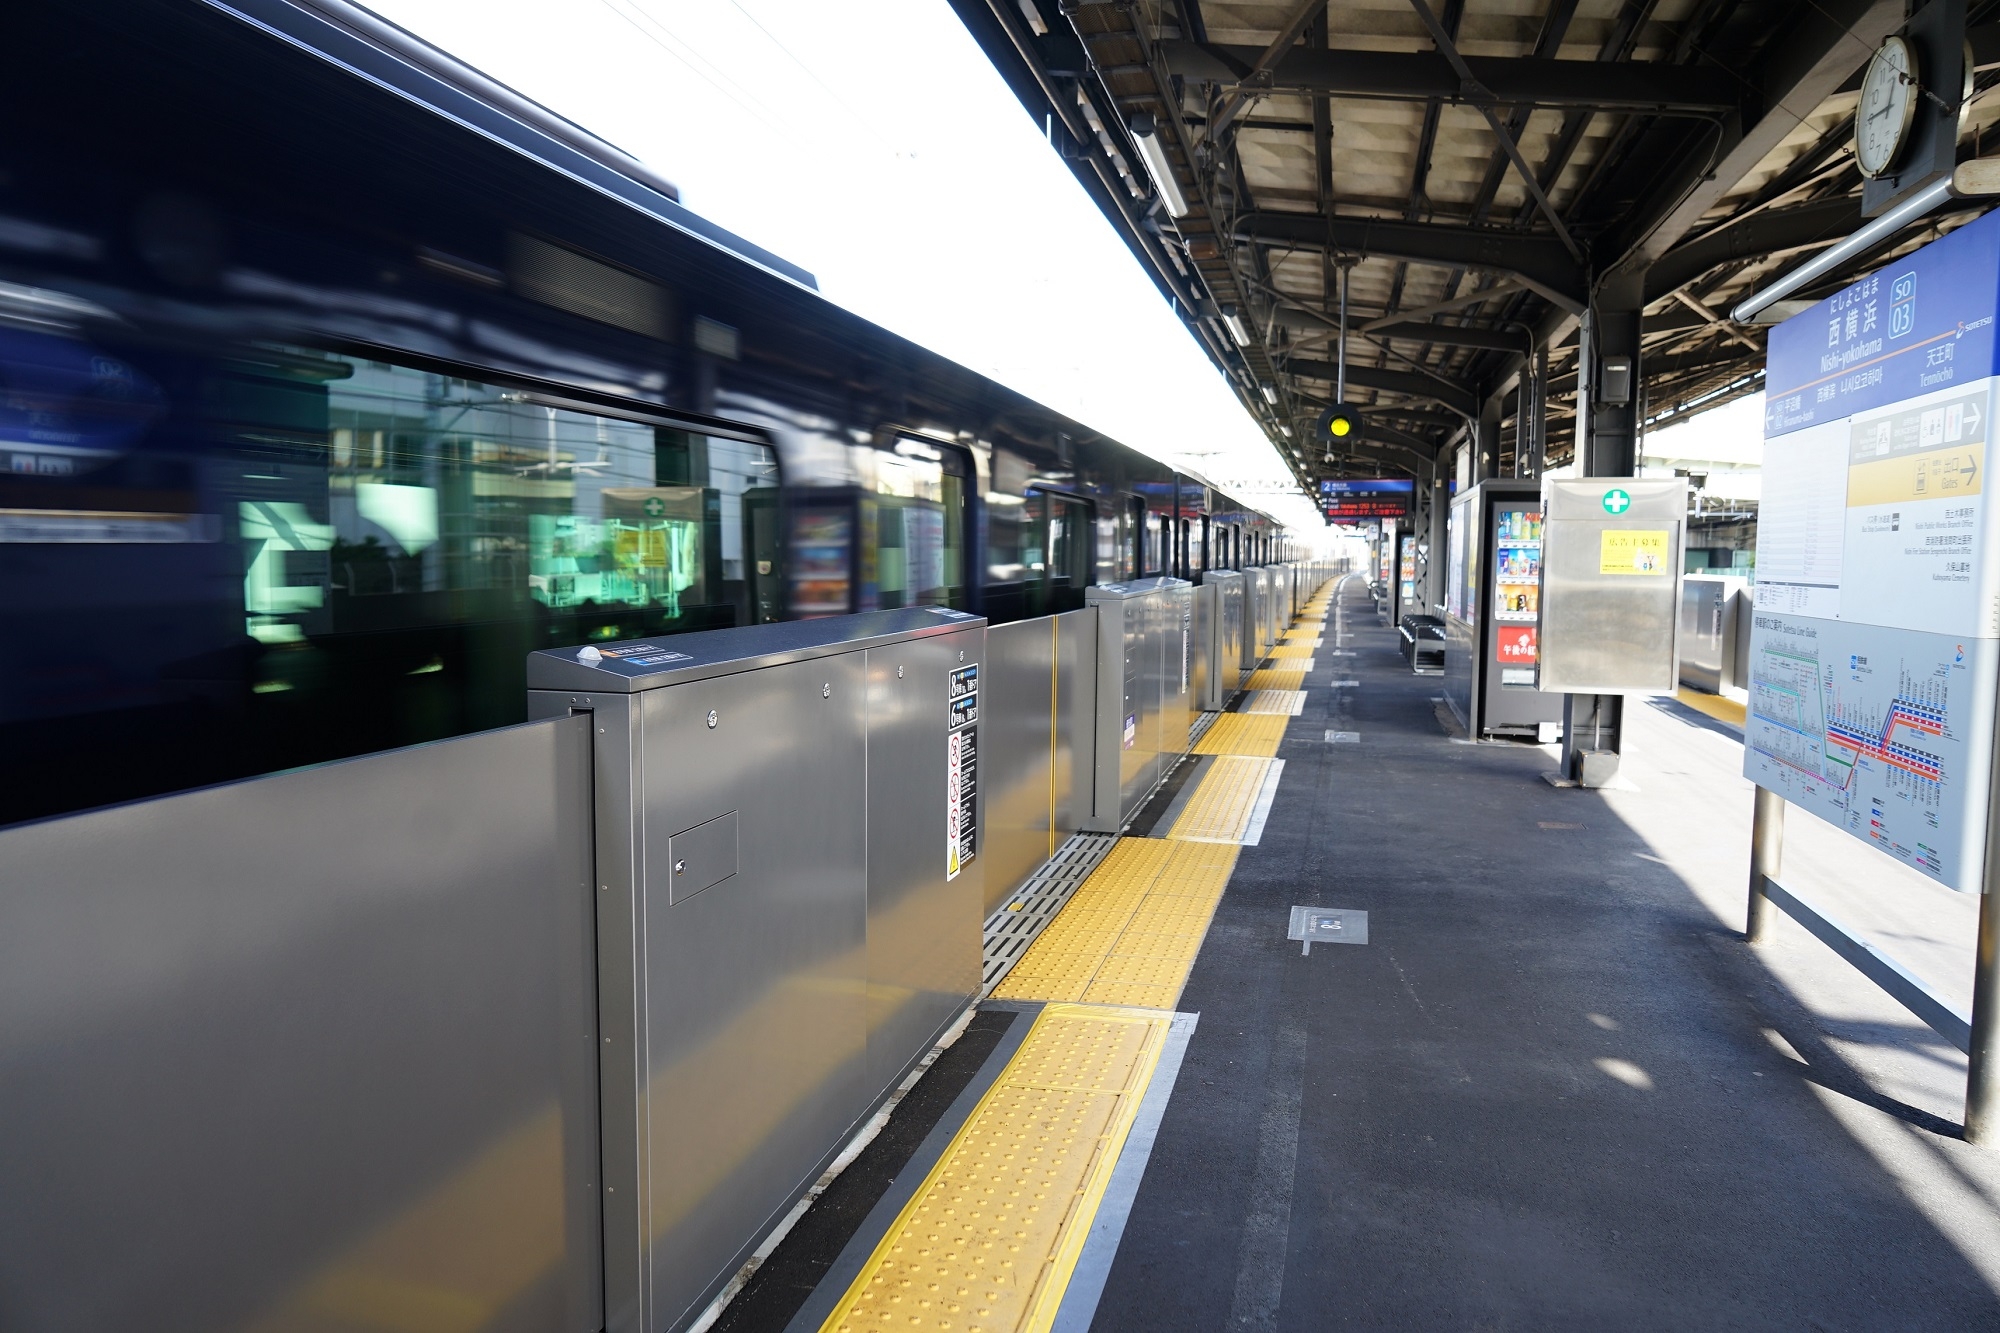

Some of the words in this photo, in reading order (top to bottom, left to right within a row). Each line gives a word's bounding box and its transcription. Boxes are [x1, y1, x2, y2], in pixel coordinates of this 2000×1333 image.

[1880, 67, 1886, 86] 11
[1871, 89, 1879, 107] 10
[1869, 133, 1875, 150] 8
[1875, 144, 1881, 161] 7
[1883, 143, 1889, 161] 6
[1830, 277, 1879, 314] にしよこはま
[1895, 280, 1911, 300] SO
[1828, 299, 1877, 348] 西横浜
[1892, 304, 1910, 333] 03
[1965, 316, 1992, 332] SOTETSU
[1821, 338, 1882, 373] Nishi-yokohama
[1926, 342, 1955, 367] 天王町
[1840, 366, 1883, 395] 니시요코하마
[1944, 458, 1959, 473] 出口
[1324, 482, 1330, 491] 2
[1942, 478, 1958, 489] Gates
